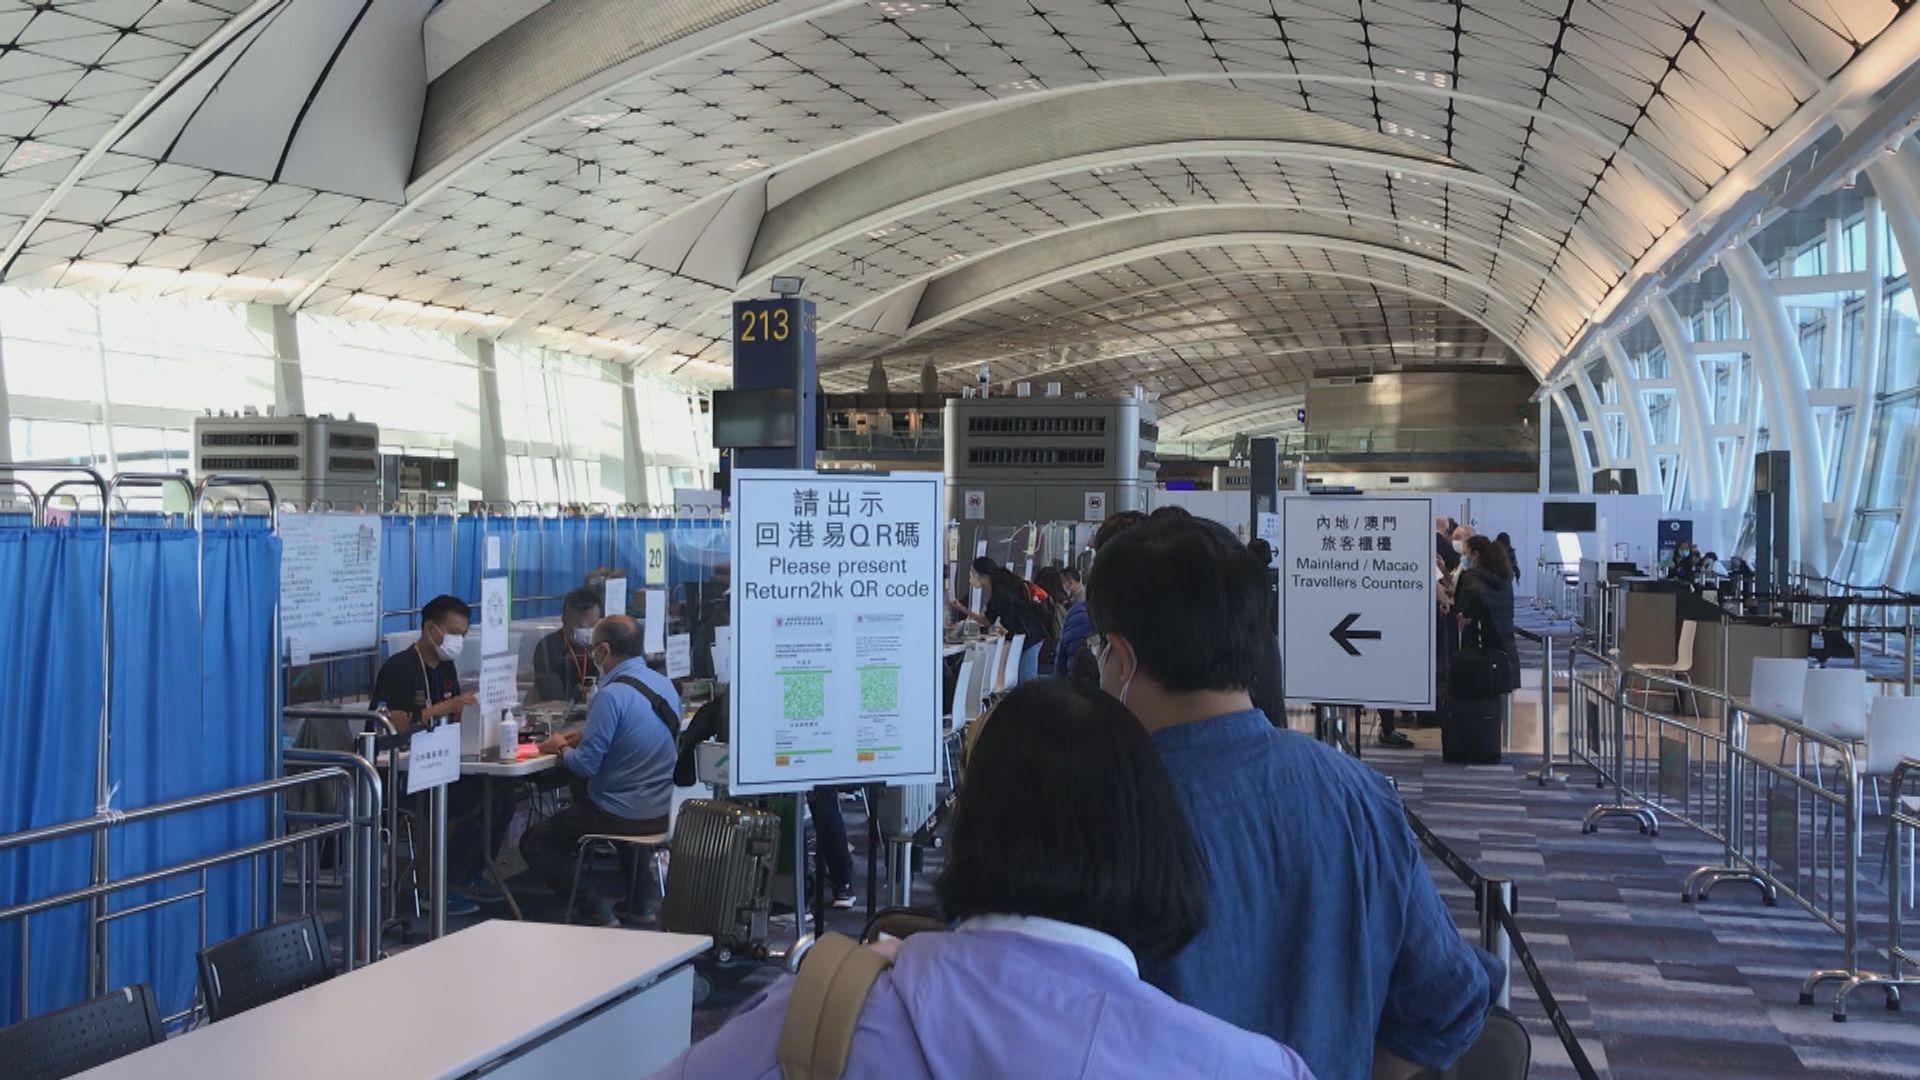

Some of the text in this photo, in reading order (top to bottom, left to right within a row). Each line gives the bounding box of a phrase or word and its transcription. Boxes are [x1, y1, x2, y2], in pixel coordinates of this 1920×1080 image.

[740, 307, 789, 342] 213
[793, 488, 884, 517] 請出示
[755, 520, 920, 549] 回港易QR碼
[1321, 536, 1393, 552] 旅客櫃檯
[648, 547, 662, 569] 20
[769, 556, 907, 578] Please present
[1296, 557, 1359, 572] Mainland
[1372, 558, 1418, 572] Macao
[745, 579, 929, 600] Return2hk QR code
[1291, 574, 1423, 590] Travellers Counters
